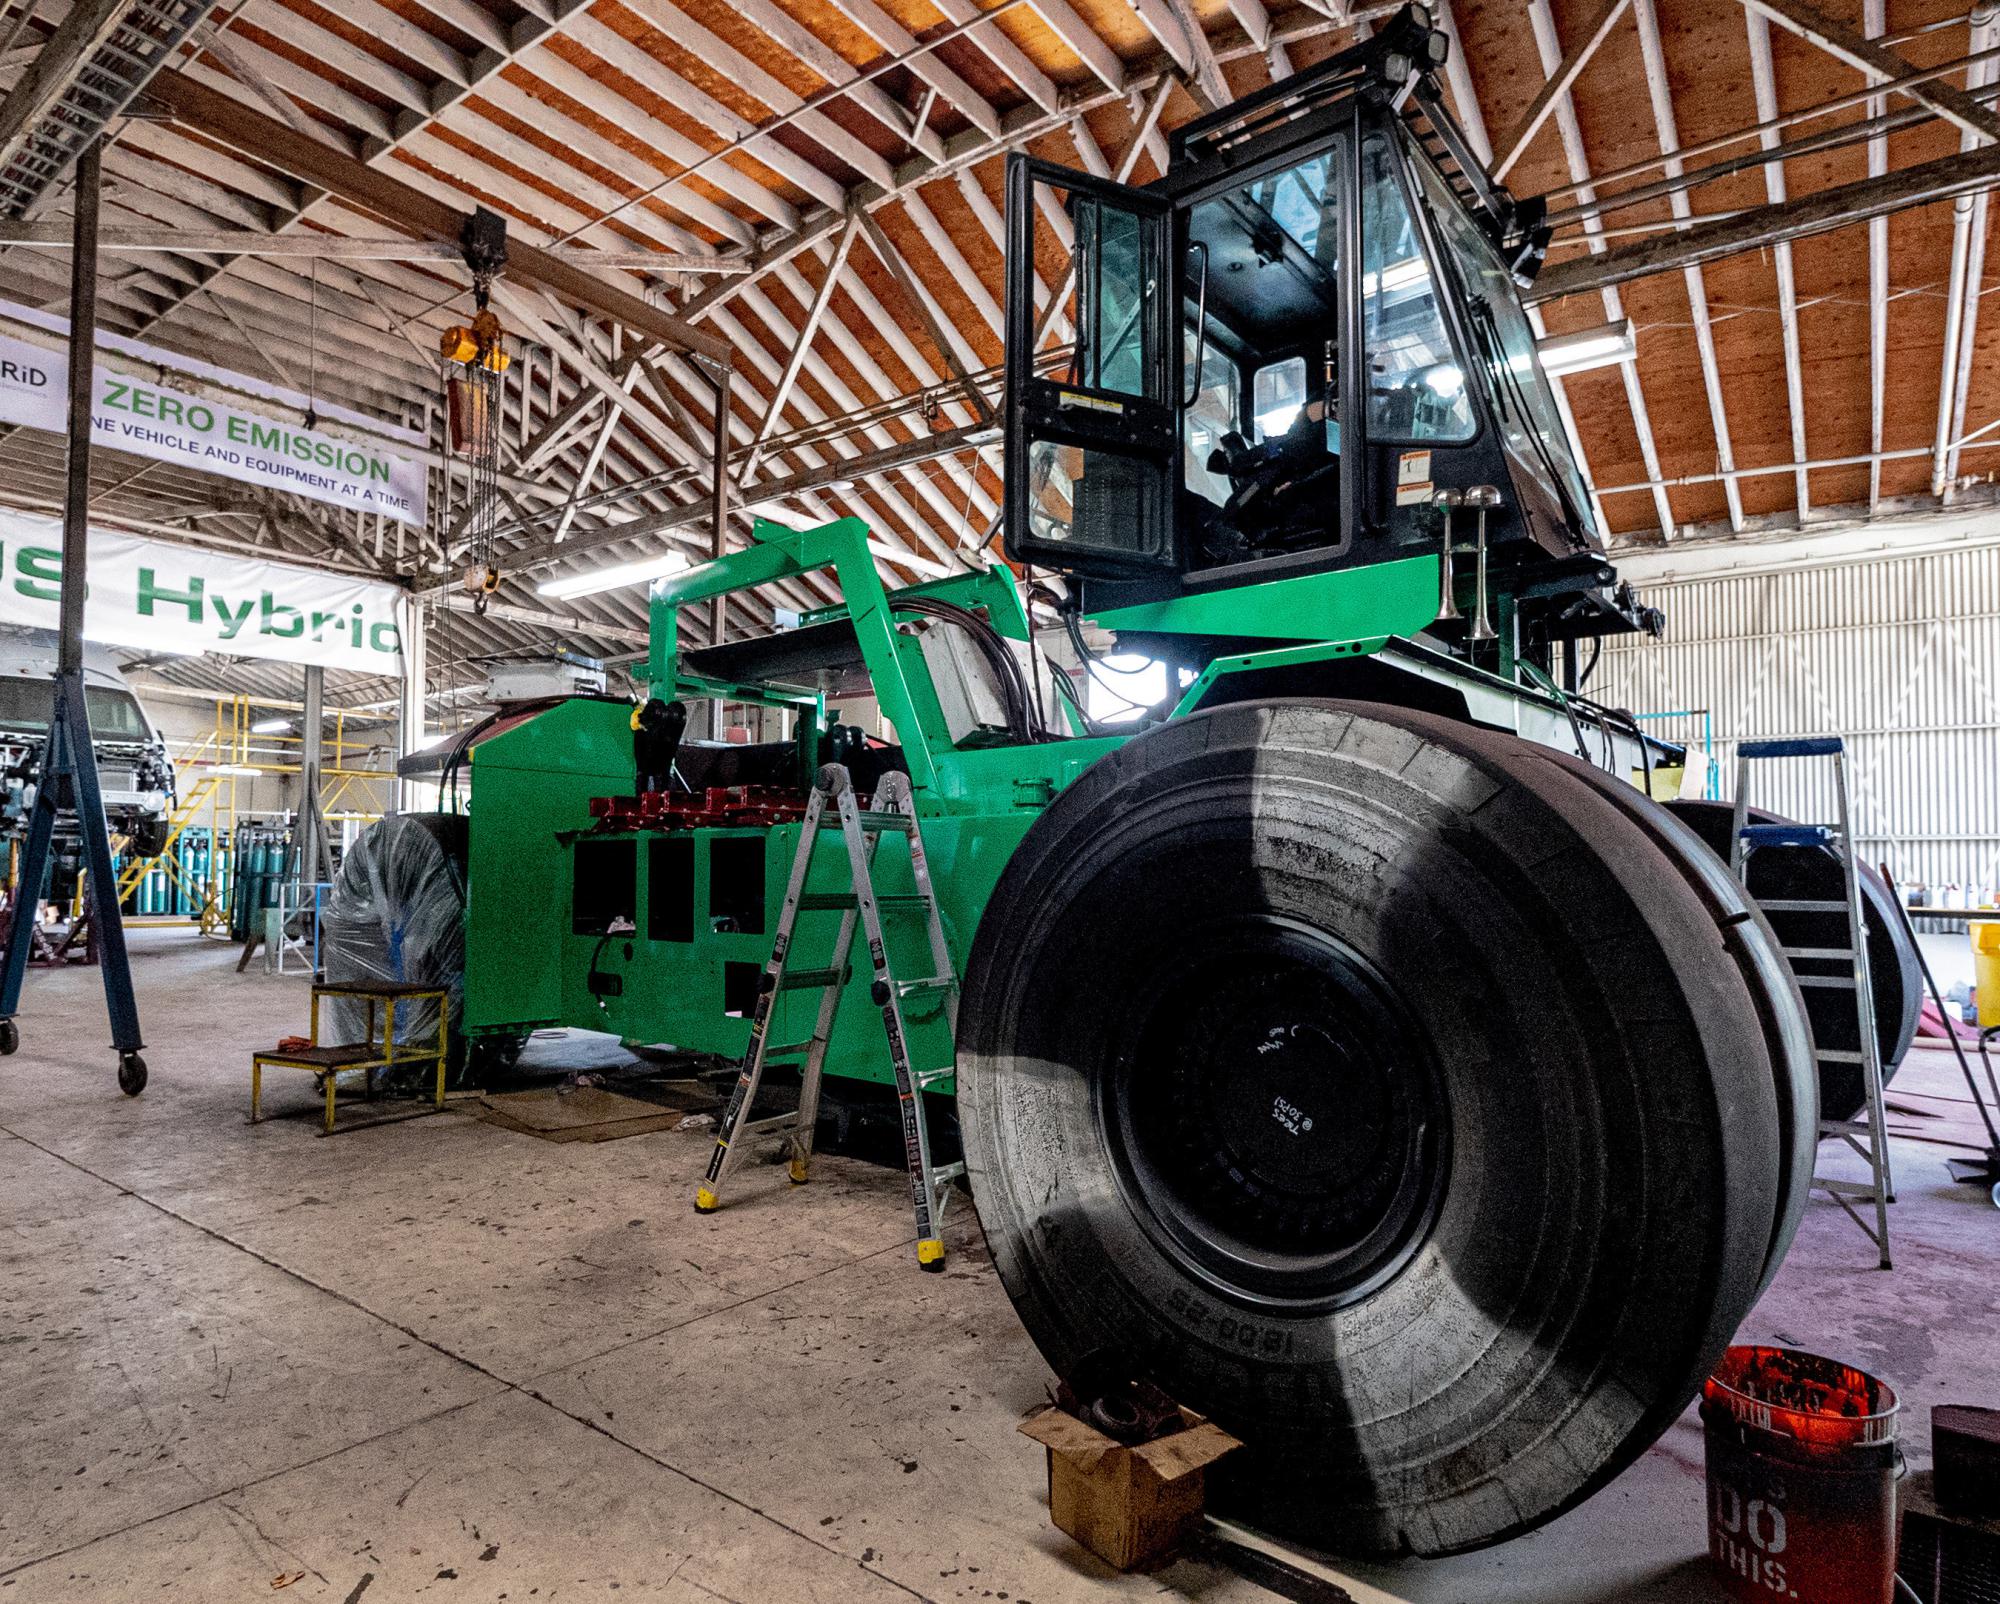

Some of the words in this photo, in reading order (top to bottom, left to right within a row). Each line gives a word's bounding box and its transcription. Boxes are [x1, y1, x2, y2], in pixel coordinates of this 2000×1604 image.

[91, 415, 116, 432] NE
[122, 423, 200, 454] VEHICLE
[204, 446, 240, 465] AND
[245, 456, 338, 491] EQUIPMENT
[341, 484, 360, 497] AT
[362, 489, 373, 500] A
[377, 491, 410, 511] TIME
[102, 380, 215, 432] ZERO
[227, 415, 390, 483] EMISSION
[1716, 1485, 1787, 1554] DO
[1716, 1529, 1799, 1599] THIS.
